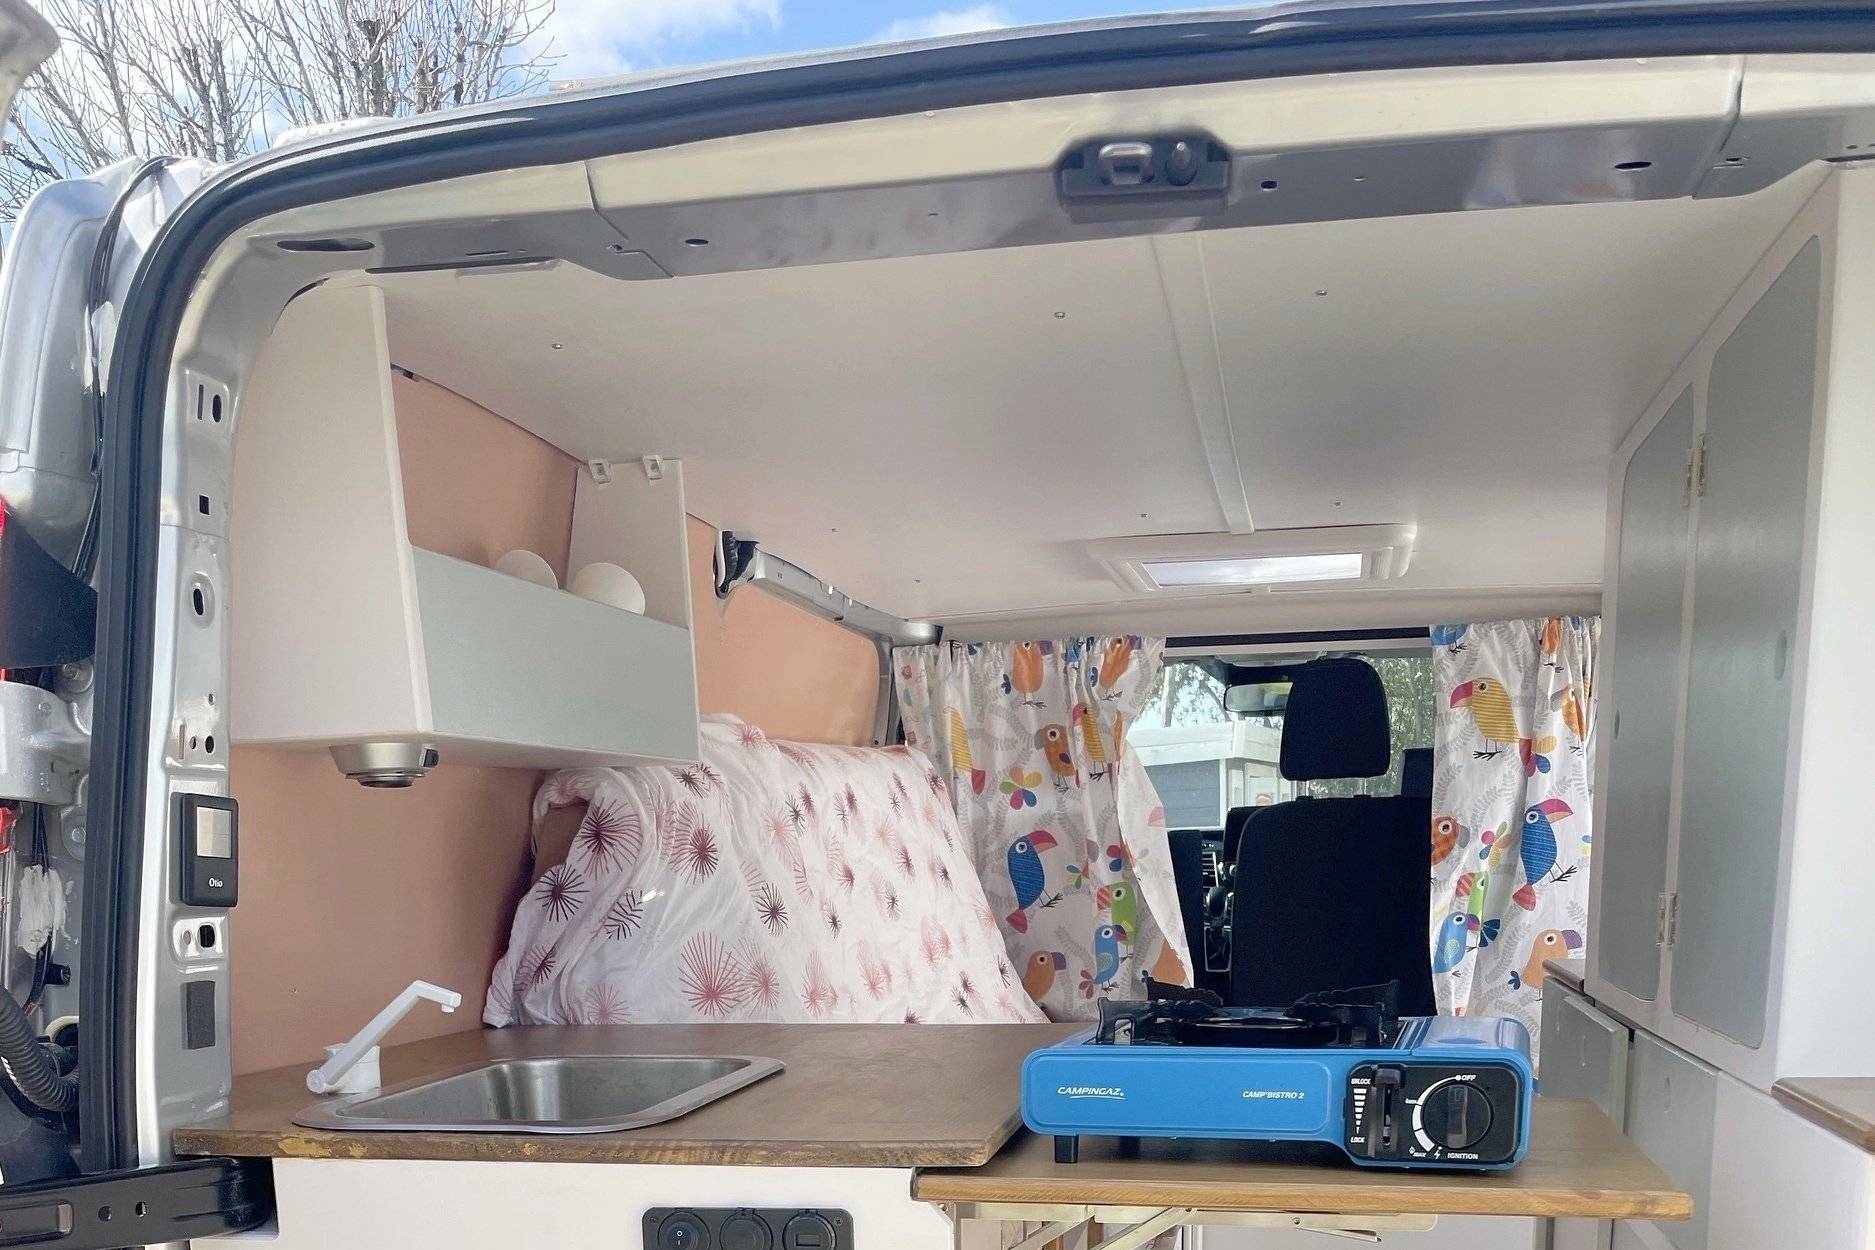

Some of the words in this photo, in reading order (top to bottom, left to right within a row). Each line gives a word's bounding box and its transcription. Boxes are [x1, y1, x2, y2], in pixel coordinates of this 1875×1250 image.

[209, 878, 223, 888] Otio
[1057, 1086, 1122, 1097] CAMPINGAZ
[1350, 1136, 1366, 1144] LOCK
[1447, 1152, 1479, 1160] IGNITION
